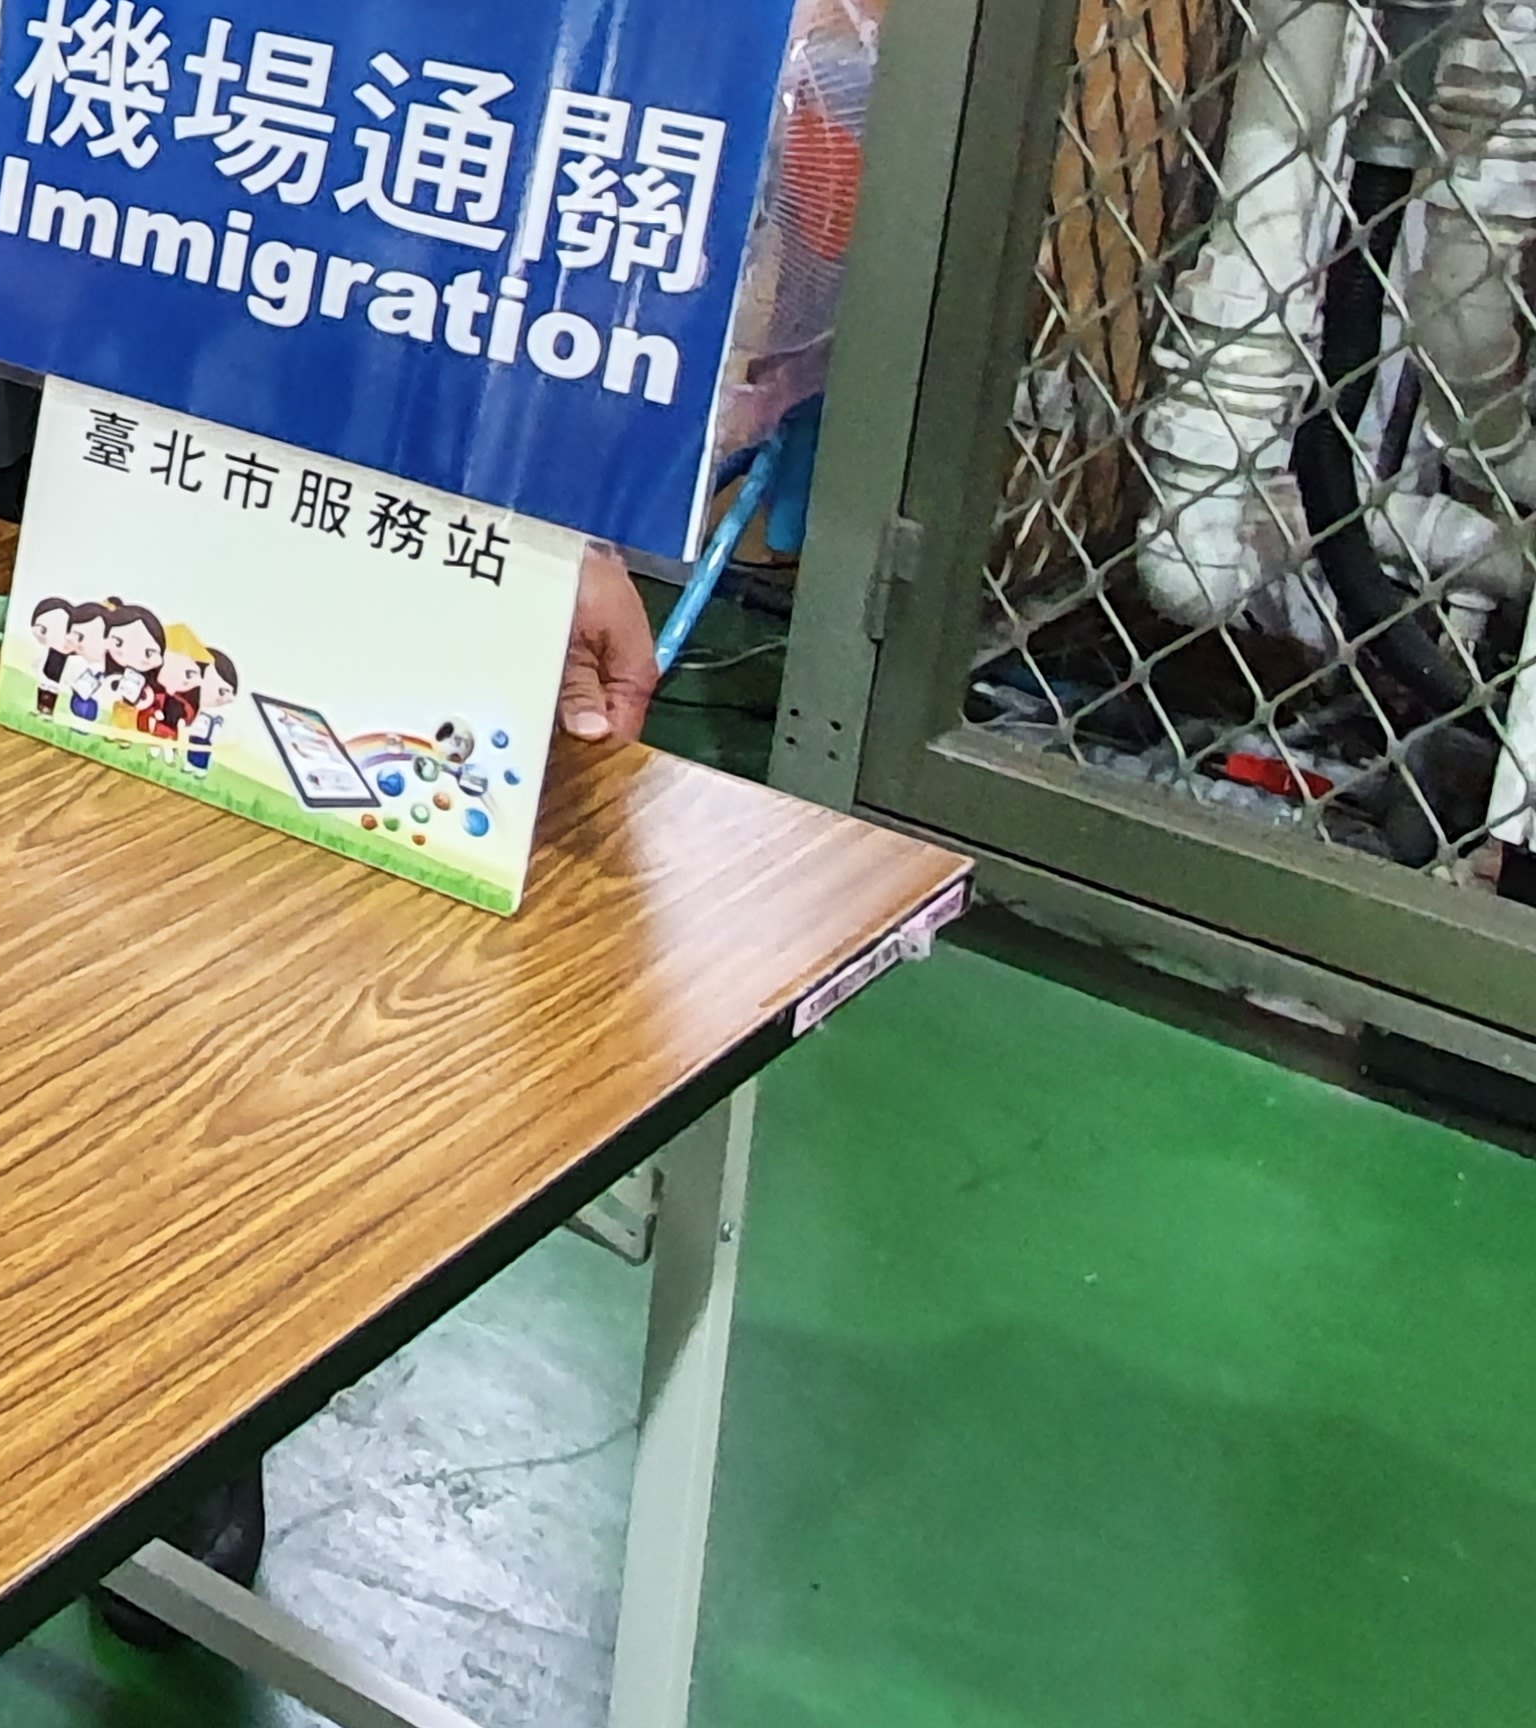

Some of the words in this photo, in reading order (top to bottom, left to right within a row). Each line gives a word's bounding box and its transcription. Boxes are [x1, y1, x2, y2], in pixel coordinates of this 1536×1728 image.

[81, 408, 510, 586] 臺北市服務站
